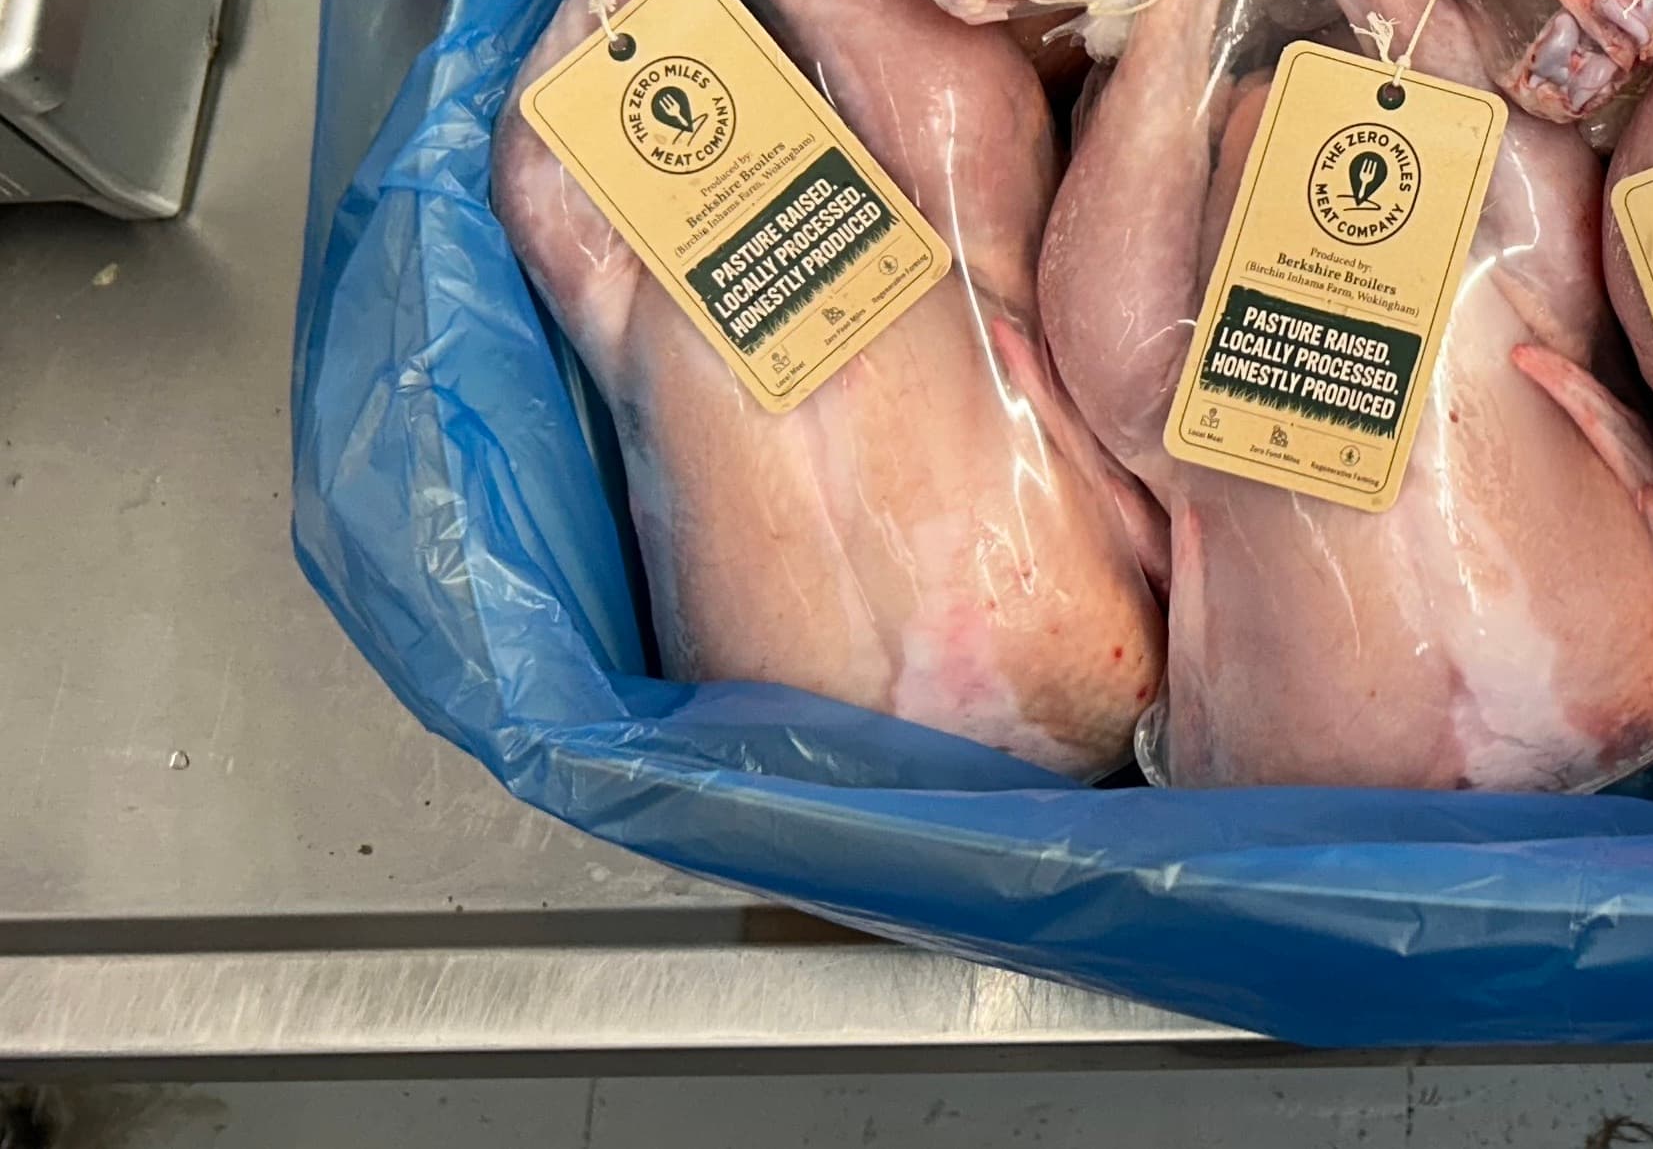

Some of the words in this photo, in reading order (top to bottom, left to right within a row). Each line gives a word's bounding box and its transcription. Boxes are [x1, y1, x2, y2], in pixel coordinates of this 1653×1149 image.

[628, 70, 661, 110] ZERO
[664, 64, 711, 89] MILES
[628, 112, 649, 144] THE
[650, 145, 693, 167] MEAT
[695, 96, 729, 162] COMPANY
[684, 180, 742, 229] Berkshire
[738, 141, 786, 183] Broilers
[699, 160, 740, 198] Produced
[1320, 141, 1346, 171] THE
[1345, 130, 1390, 148] ZERO
[1389, 143, 1413, 192] MILES
[673, 227, 709, 259] (Birchin
[706, 200, 740, 230] Inhams
[761, 132, 816, 180] Wokingham)
[1315, 183, 1340, 223] MEAT
[1337, 203, 1404, 238] COMPANY
[711, 222, 783, 289] PASTURE
[775, 178, 838, 233] RAISED.
[714, 256, 779, 319] LOCALLY
[773, 186, 867, 267] PROCESSED.
[1310, 246, 1357, 268] Produced
[1357, 259, 1373, 273] by:
[729, 265, 806, 338] HONESTLY
[800, 201, 882, 276] PRODUCED
[1245, 260, 1286, 280] (Birchin
[1286, 271, 1325, 290] Inhams
[1357, 290, 1420, 319] Wokingham)
[1276, 252, 1342, 281] Berkshire
[1343, 270, 1397, 296] Broilers
[1219, 326, 1295, 365] LOCALLY
[1293, 347, 1399, 396] PROCESSED.
[1242, 306, 1324, 346] PASTURE
[1323, 328, 1390, 366] RAISED.
[1210, 351, 1302, 394] HONESTLY
[1300, 376, 1396, 420] PRODUCED
